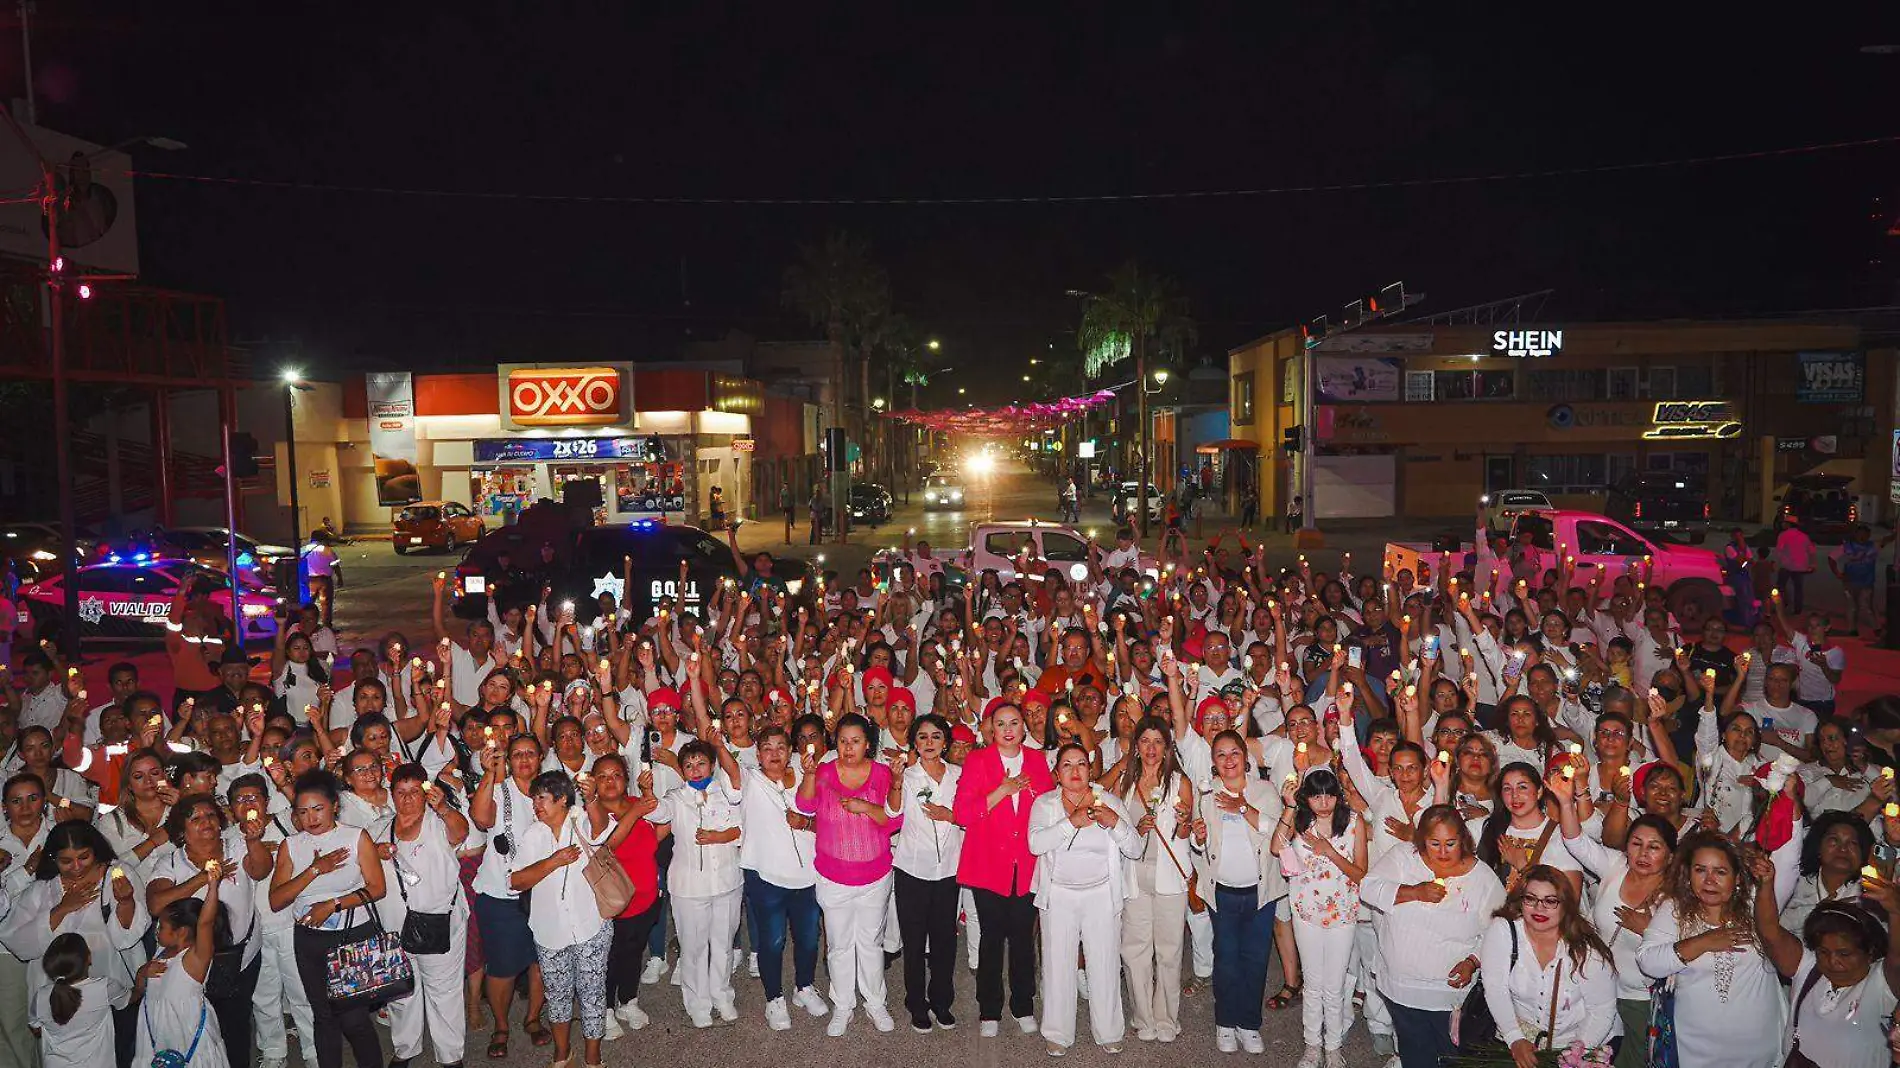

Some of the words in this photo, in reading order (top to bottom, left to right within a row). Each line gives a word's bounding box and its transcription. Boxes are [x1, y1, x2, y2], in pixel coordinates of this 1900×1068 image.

[1493, 330, 1562, 350] SHEIN
[1803, 362, 1856, 381] VISAS
[513, 377, 615, 416] OXXO
[1656, 403, 1711, 421] VISAS
[733, 442, 754, 451] OXXO
